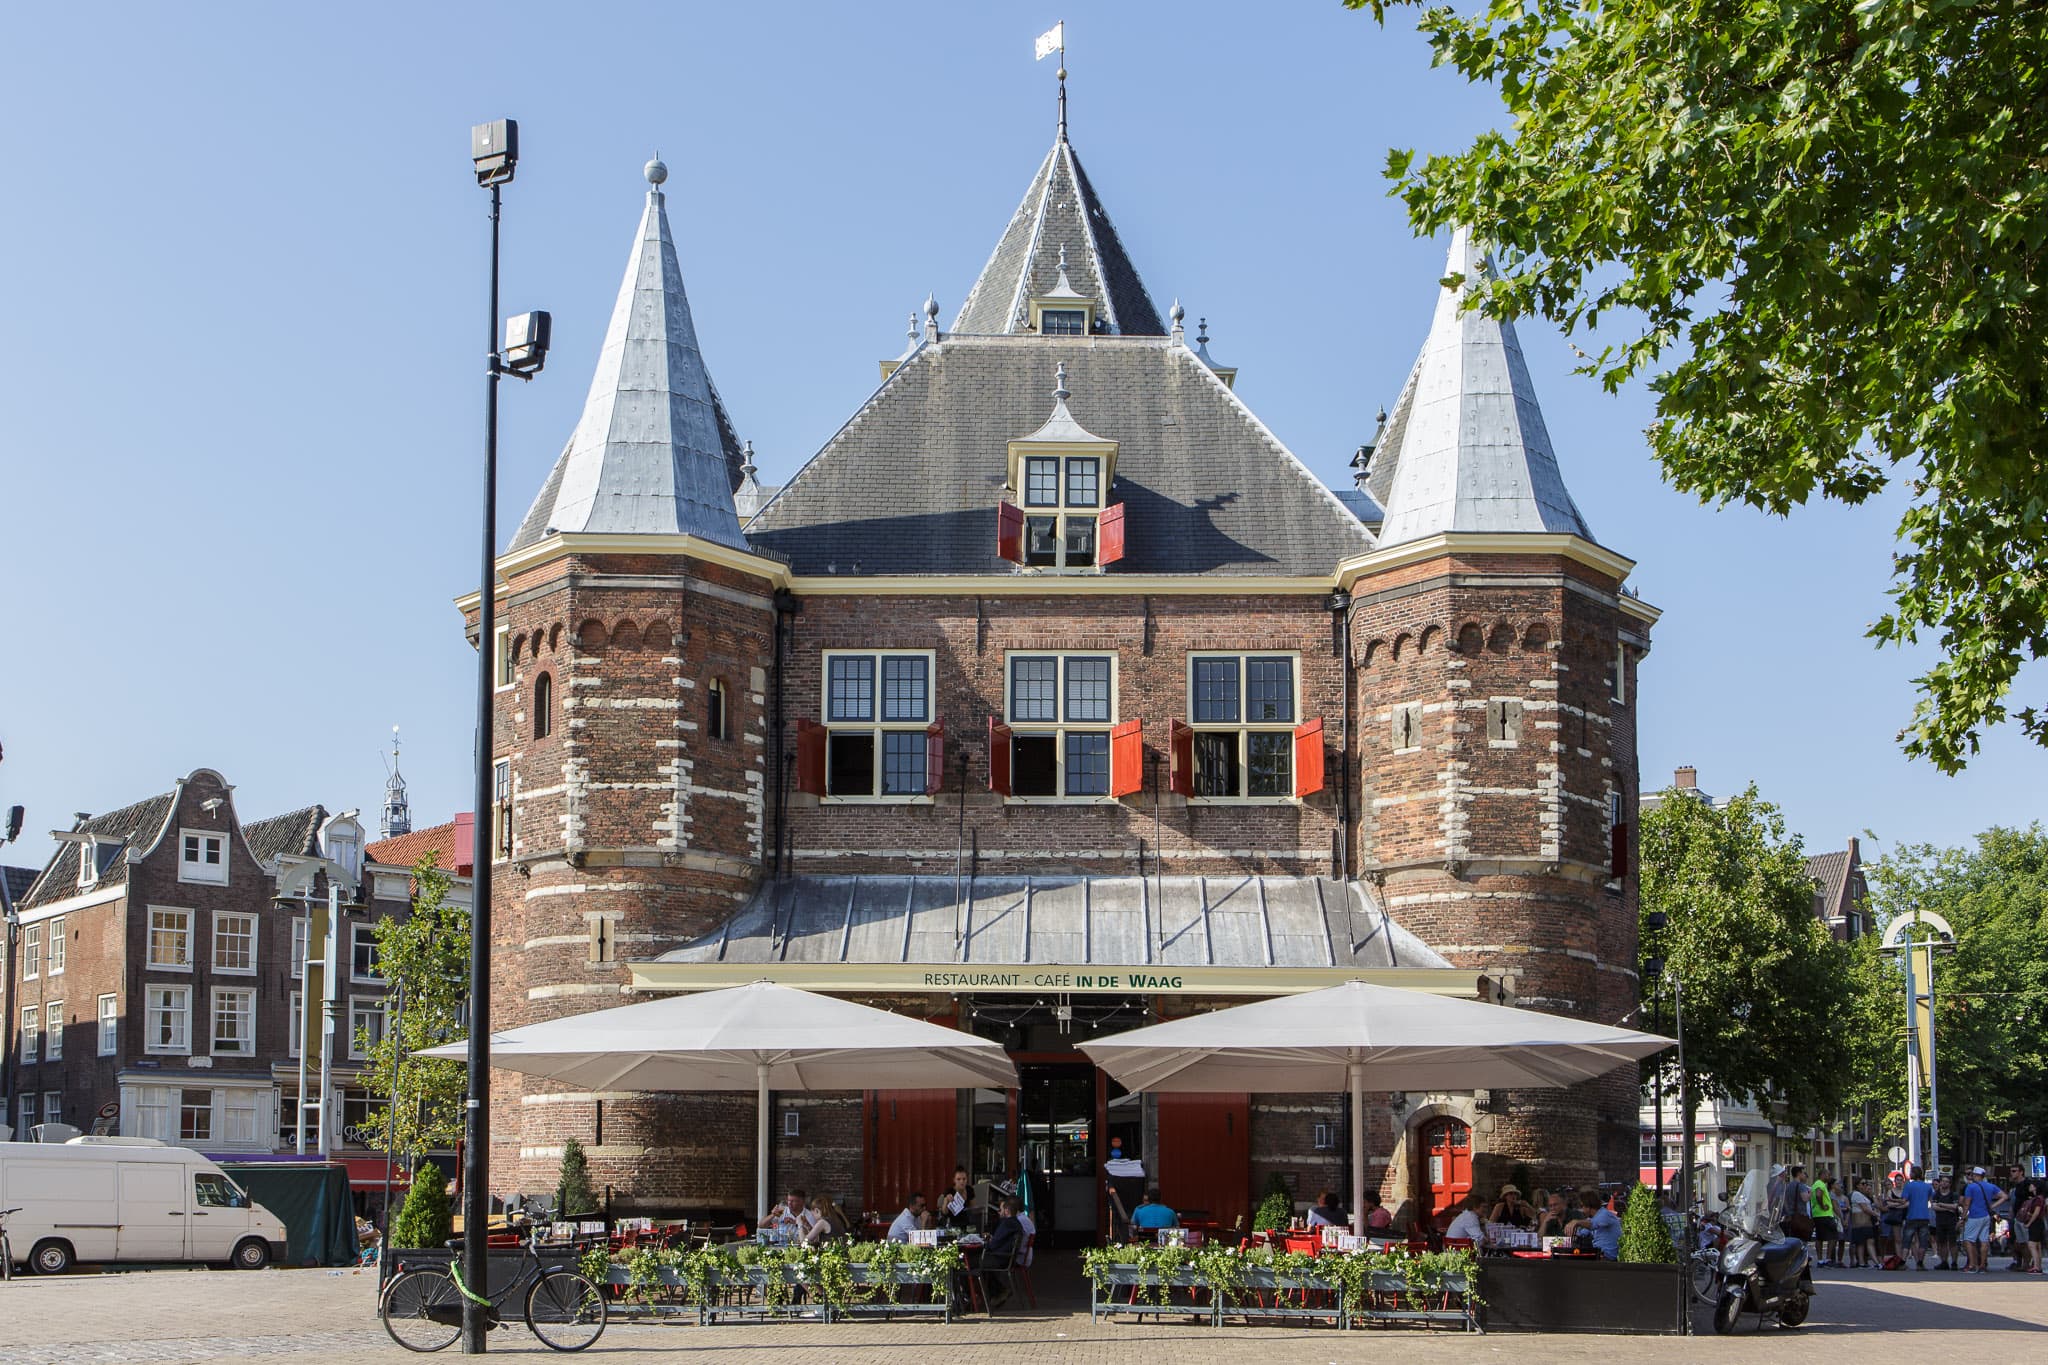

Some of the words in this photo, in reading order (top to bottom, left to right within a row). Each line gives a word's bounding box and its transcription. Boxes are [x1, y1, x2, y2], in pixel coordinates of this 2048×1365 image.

[924, 973, 1021, 986] RESTAURANT
[1034, 972, 1071, 987] CAFÉ
[1076, 975, 1093, 988] IN
[1098, 975, 1119, 988] DE
[1129, 974, 1182, 988] WAAG
